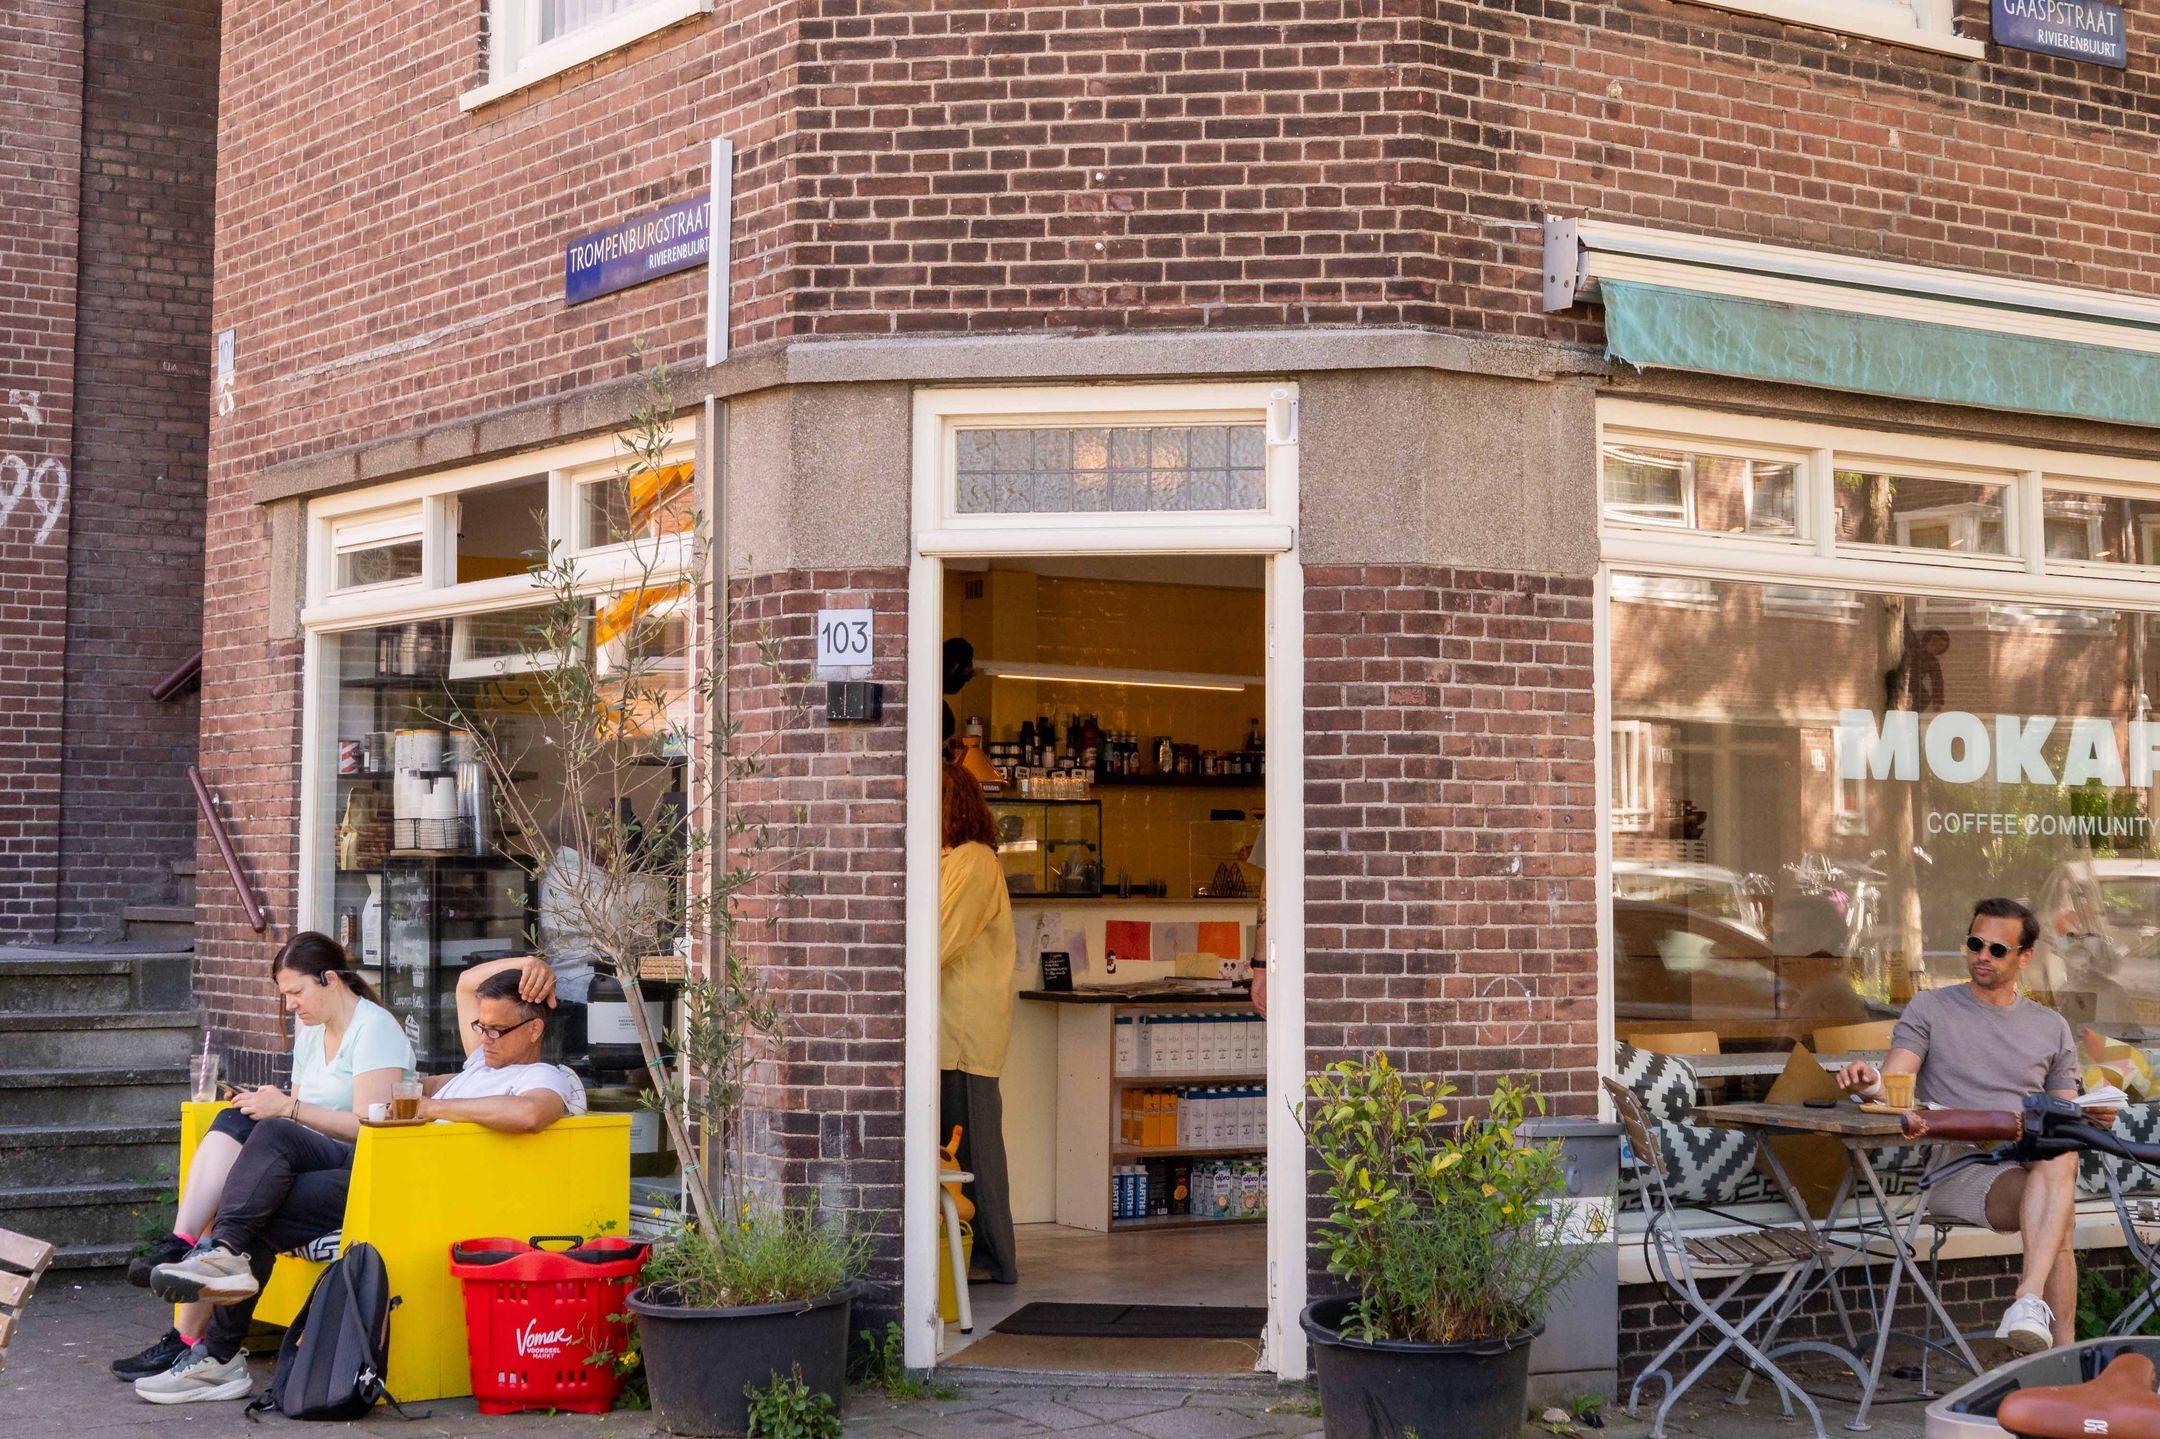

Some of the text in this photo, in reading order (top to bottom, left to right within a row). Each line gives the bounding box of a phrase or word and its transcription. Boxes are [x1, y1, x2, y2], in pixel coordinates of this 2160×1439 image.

[2003, 0, 2117, 36] GAASPSTRAAT
[2038, 29, 2116, 57] RIVIERENBUURT
[570, 203, 712, 273] TROMPENBURGSTRAAT
[649, 236, 711, 270] RIVIERENBUURT
[822, 621, 869, 654] 103
[1926, 811, 2160, 837] COFFEE COMMUNITY
